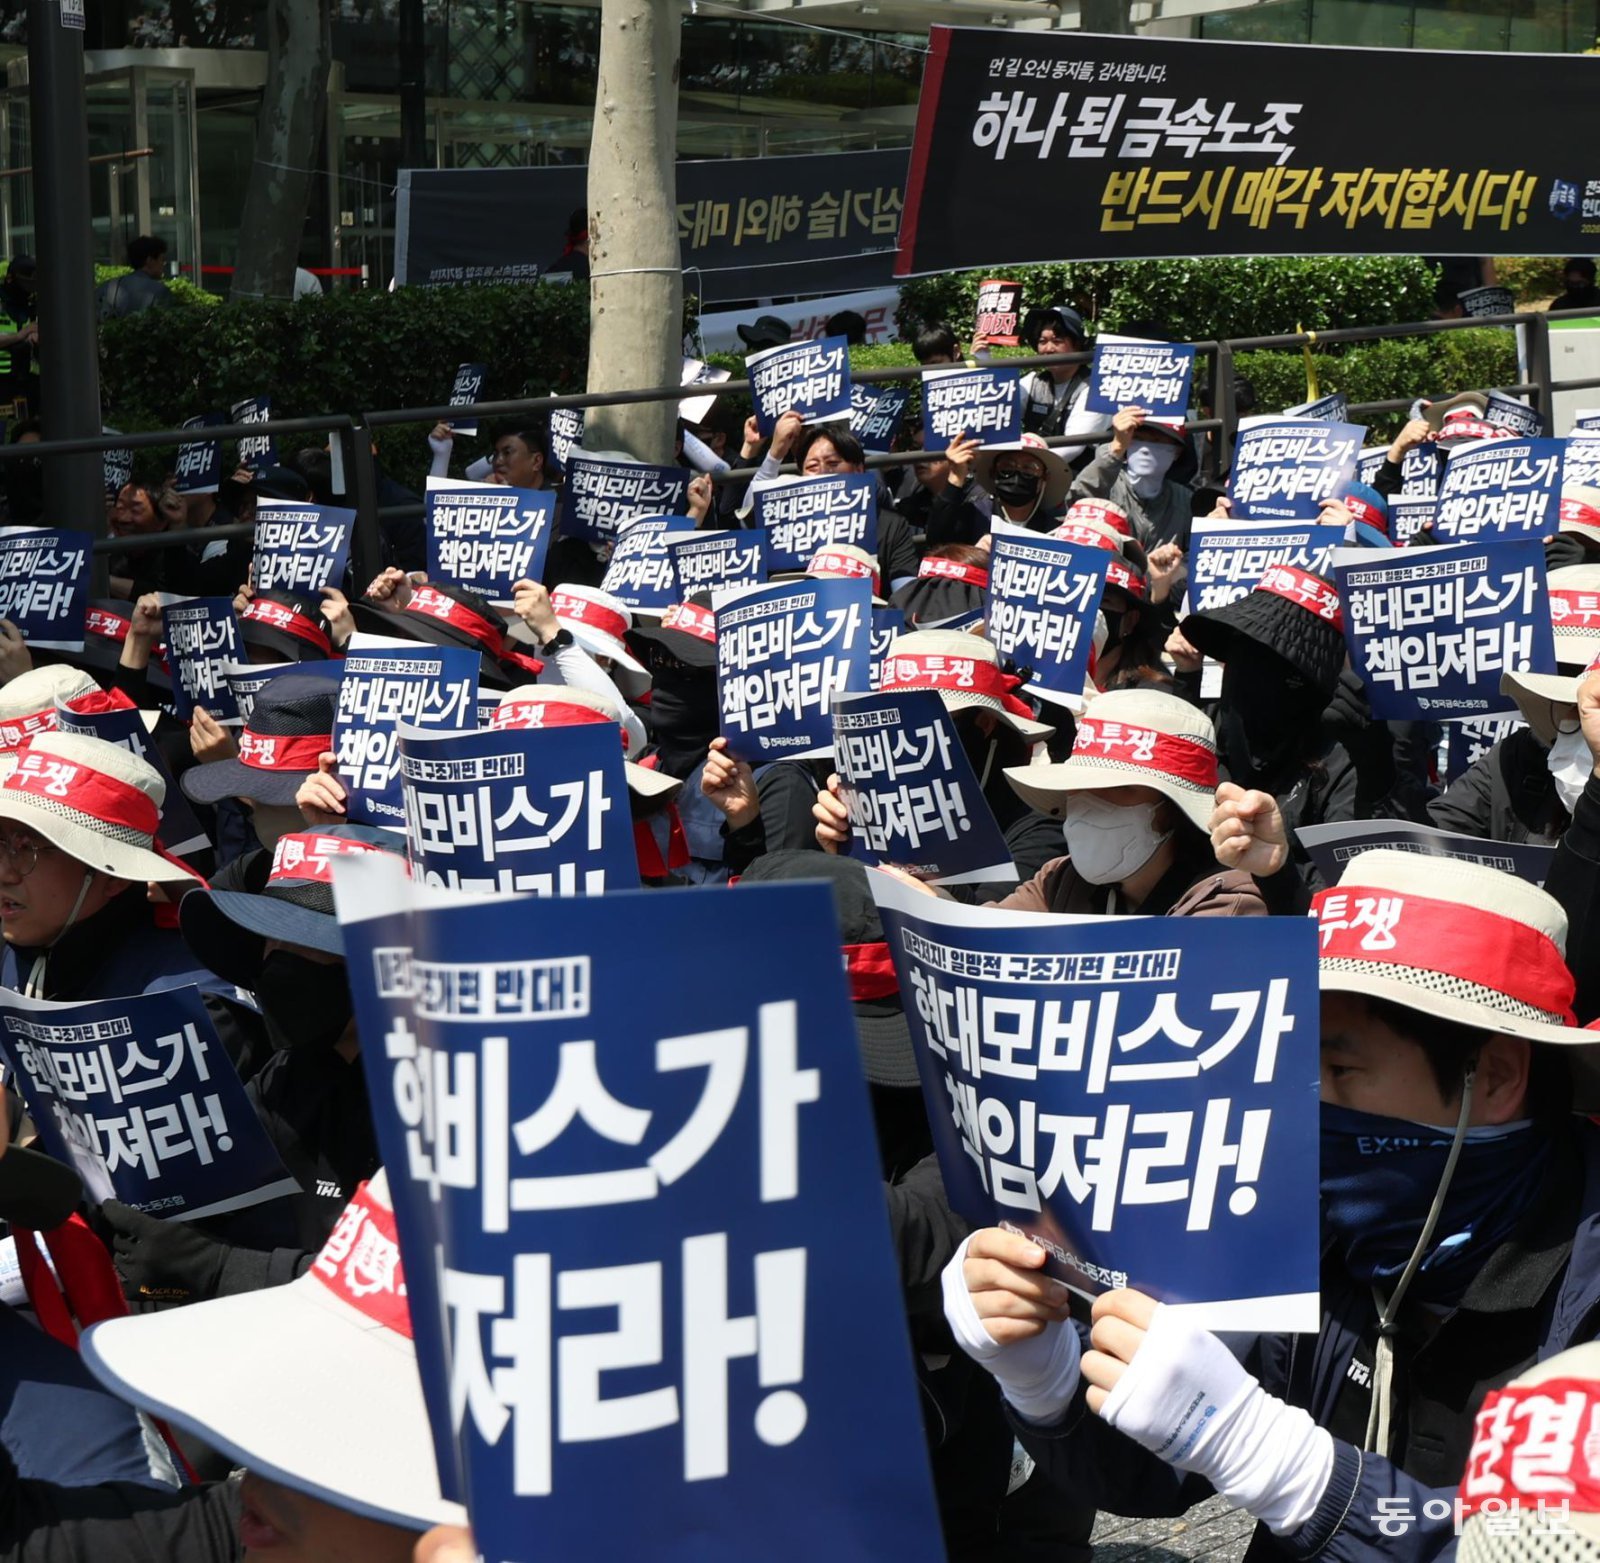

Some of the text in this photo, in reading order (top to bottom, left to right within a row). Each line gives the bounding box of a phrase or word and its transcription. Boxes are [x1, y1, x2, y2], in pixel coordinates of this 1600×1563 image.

[989, 58, 1167, 83] 먼 길 오신 동지들, 감사합니다.
[972, 91, 1304, 166] 하나 된 금속노조,
[1100, 166, 1538, 232] 반드시 매각 저지합시다!
[753, 347, 845, 396] 현대모비스가
[1098, 354, 1190, 378] 현대모비스가
[761, 373, 842, 419] 책임져라!
[927, 380, 1016, 413] 현대모비스가
[1099, 375, 1184, 405] 책임져라!
[931, 403, 1013, 438] 책임져라!
[1236, 437, 1356, 470] 현대모비스가
[572, 470, 682, 504] 현대모비스가
[1233, 466, 1340, 504] 책임져라!
[1441, 456, 1559, 500] 현대모비스가
[433, 507, 545, 540] 현대모비스가
[763, 486, 871, 526] 현대모비스가
[1437, 490, 1549, 537] 책임져라!
[770, 514, 865, 554] 책임져라!
[0, 549, 84, 580] 대모비스가
[438, 540, 534, 581] 책임져라!
[678, 544, 761, 584] 현대모비스가
[1385, 570, 1413, 582] 일방적
[1416, 563, 1456, 578] 구조개편
[1460, 558, 1486, 572] 반대!
[0, 581, 75, 621] 임져라!
[413, 590, 455, 617] 투쟁
[756, 601, 787, 616] 구조개편
[791, 593, 815, 610] 반대!
[991, 556, 1098, 613] 현대모비스가
[1294, 578, 1340, 620] 투쟁
[1349, 566, 1538, 635] 현대모비스가
[86, 612, 121, 635] 투쟁
[254, 602, 293, 628] 투쟁
[552, 595, 587, 617] 투쟁
[718, 603, 862, 677] 현대모비스가
[990, 600, 1081, 664] 책임져라!
[373, 659, 397, 672] 일방적
[398, 661, 425, 673] 구조개편
[922, 656, 974, 687] 투쟁
[1365, 621, 1534, 691] 책임져라!
[337, 677, 470, 728] 현대모비스가
[880, 708, 900, 725] 반대!
[241, 732, 275, 765] 투쟁
[1096, 723, 1157, 761] 투쟁
[17, 754, 78, 796] 투쟁
[425, 756, 523, 781] 구조개편 반대!
[1319, 894, 1403, 950] 투쟁
[903, 931, 1176, 981] 매각저지! 일방적 구조개편 반대!
[496, 963, 584, 1012] 반대!
[53, 1021, 95, 1041] 구조개편
[98, 1017, 130, 1036] 반대!
[910, 966, 1295, 1093] 현대모비스가
[15, 1022, 210, 1104] 현대모비스가
[945, 1071, 1271, 1232] 책임져라!
[1466, 1391, 1587, 1498] 단결
